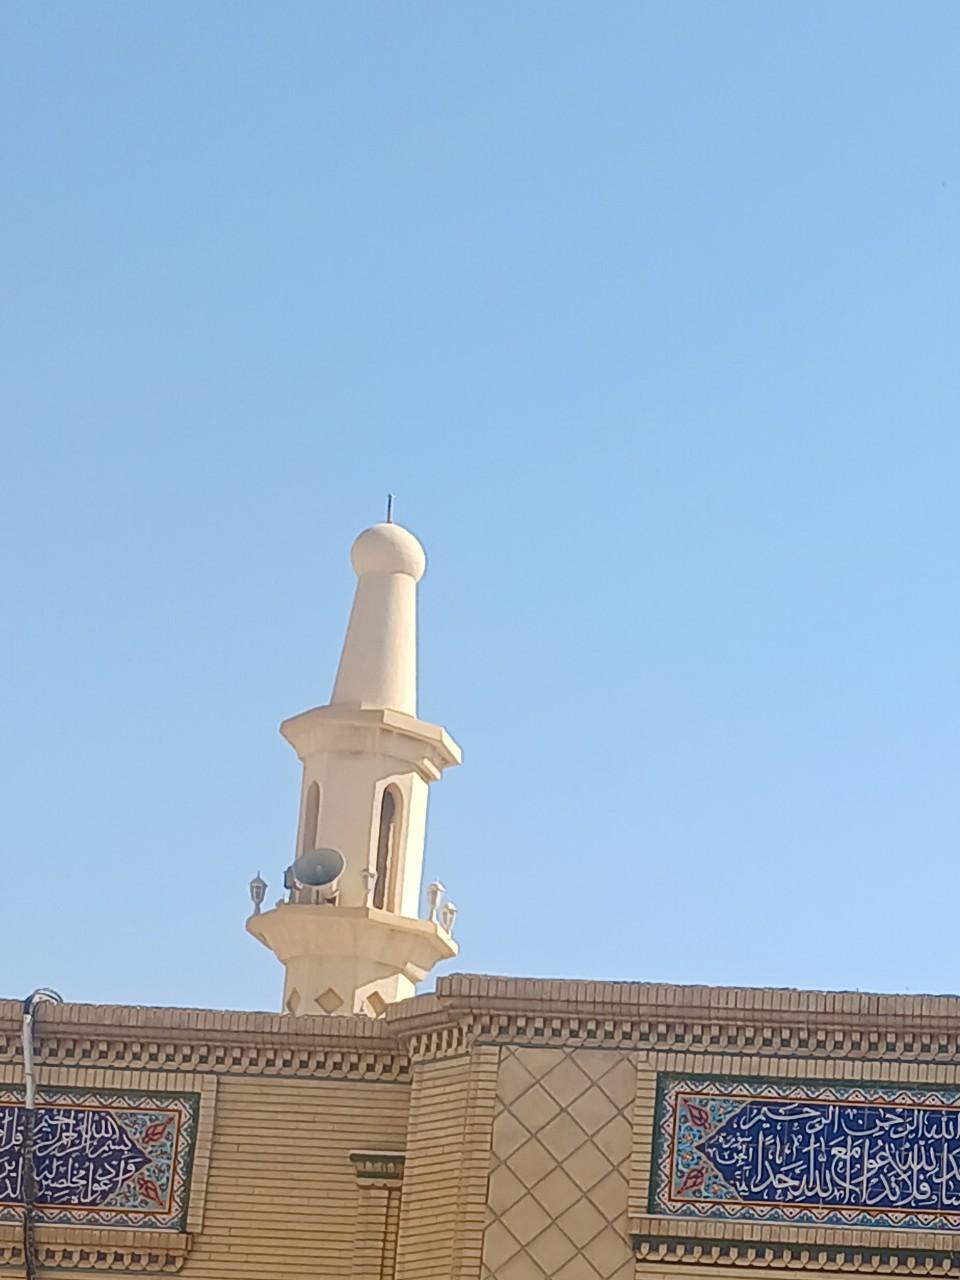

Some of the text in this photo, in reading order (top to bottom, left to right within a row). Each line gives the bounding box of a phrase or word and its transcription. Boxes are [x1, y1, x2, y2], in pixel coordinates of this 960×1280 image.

[92, 1113, 119, 1142] الله
[740, 1103, 838, 1135] الرحيم
[840, 1106, 922, 1139] الرحمن
[923, 1110, 960, 1139] الله
